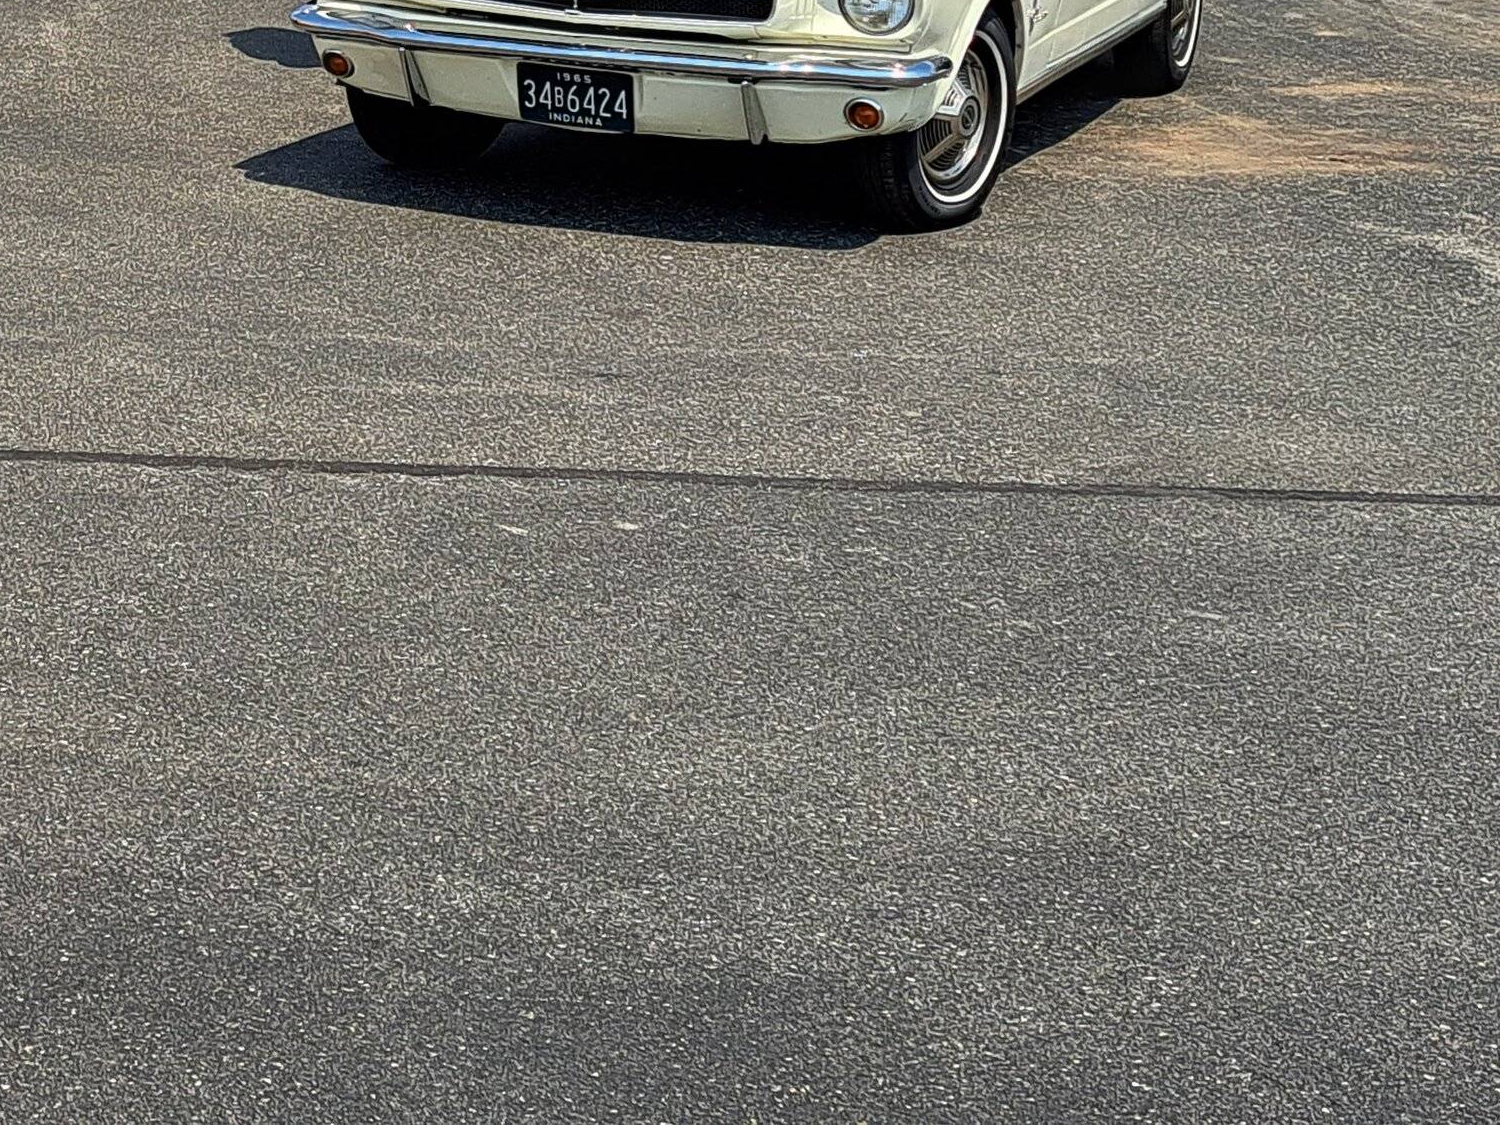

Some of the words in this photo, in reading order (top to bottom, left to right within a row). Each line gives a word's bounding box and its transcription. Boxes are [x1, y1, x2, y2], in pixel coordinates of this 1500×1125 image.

[557, 71, 592, 84] 1965
[523, 79, 627, 119] 34B6424
[548, 112, 602, 126] INDIANA
